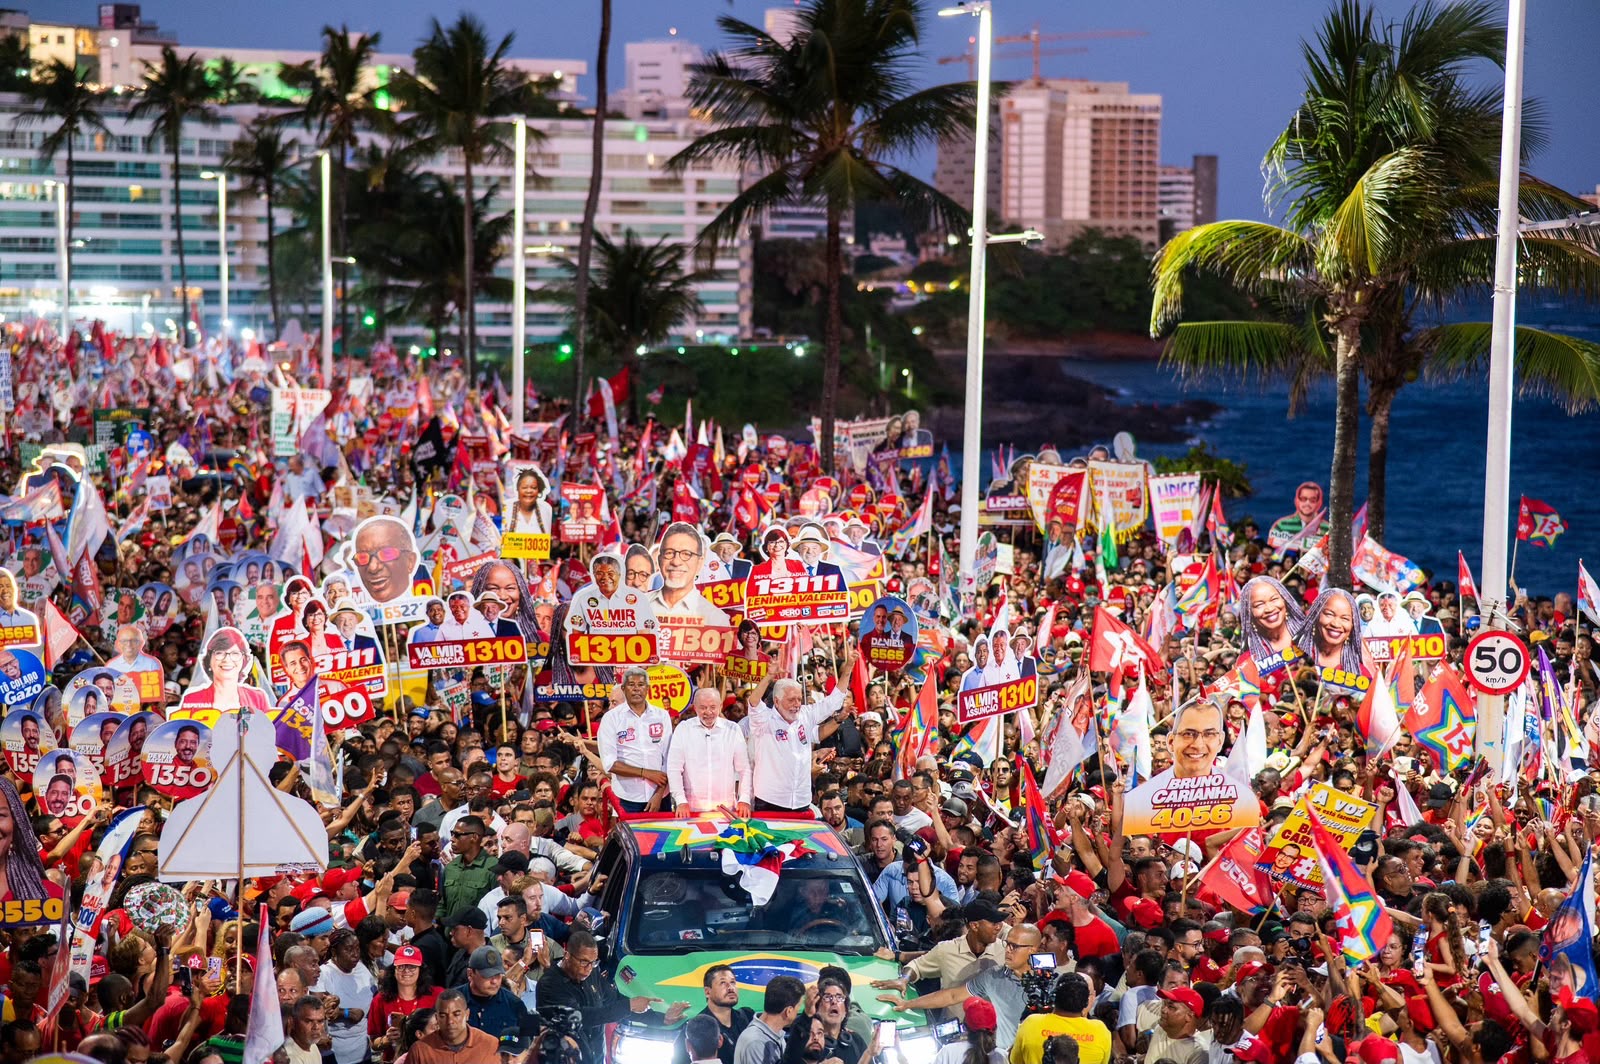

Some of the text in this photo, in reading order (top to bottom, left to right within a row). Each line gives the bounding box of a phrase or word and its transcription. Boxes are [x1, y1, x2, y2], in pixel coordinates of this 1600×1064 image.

[524, 538, 549, 551] 13033
[755, 575, 840, 595] 13111
[748, 592, 848, 606] LENINHA VALENTE
[587, 608, 636, 622] VALMIR
[592, 620, 636, 629] ASSUNÇÃO
[527, 643, 550, 657] 50
[574, 636, 651, 663] 1310
[672, 628, 734, 653] 1301
[314, 647, 376, 673] 3111
[415, 640, 523, 662] VALMIR 1310
[420, 654, 465, 666] ASSUNÇÃO
[870, 648, 904, 660] 6565
[1474, 646, 1522, 674] 50
[340, 667, 383, 680] VALENTE
[726, 656, 768, 677] 1311
[10, 671, 38, 688] COLADO
[140, 672, 158, 685] 13
[1322, 668, 1370, 690] 6550
[1486, 676, 1506, 684] km/h
[4, 684, 42, 705] Gazo
[140, 685, 159, 698] 21
[582, 684, 613, 698] 655
[964, 680, 1036, 710] VALMIR 1310
[966, 702, 998, 718] ASSUNÇÃO
[650, 724, 662, 734] 13
[1443, 722, 1472, 756] 13
[12, 752, 40, 773] 135
[114, 756, 140, 784] 135
[151, 764, 212, 788] 1350
[1167, 775, 1224, 790] BRUNO
[1152, 786, 1238, 804] CARIANHA
[1312, 790, 1368, 818] A VOZ
[1151, 804, 1232, 828] 4056
[0, 898, 63, 923] 550
